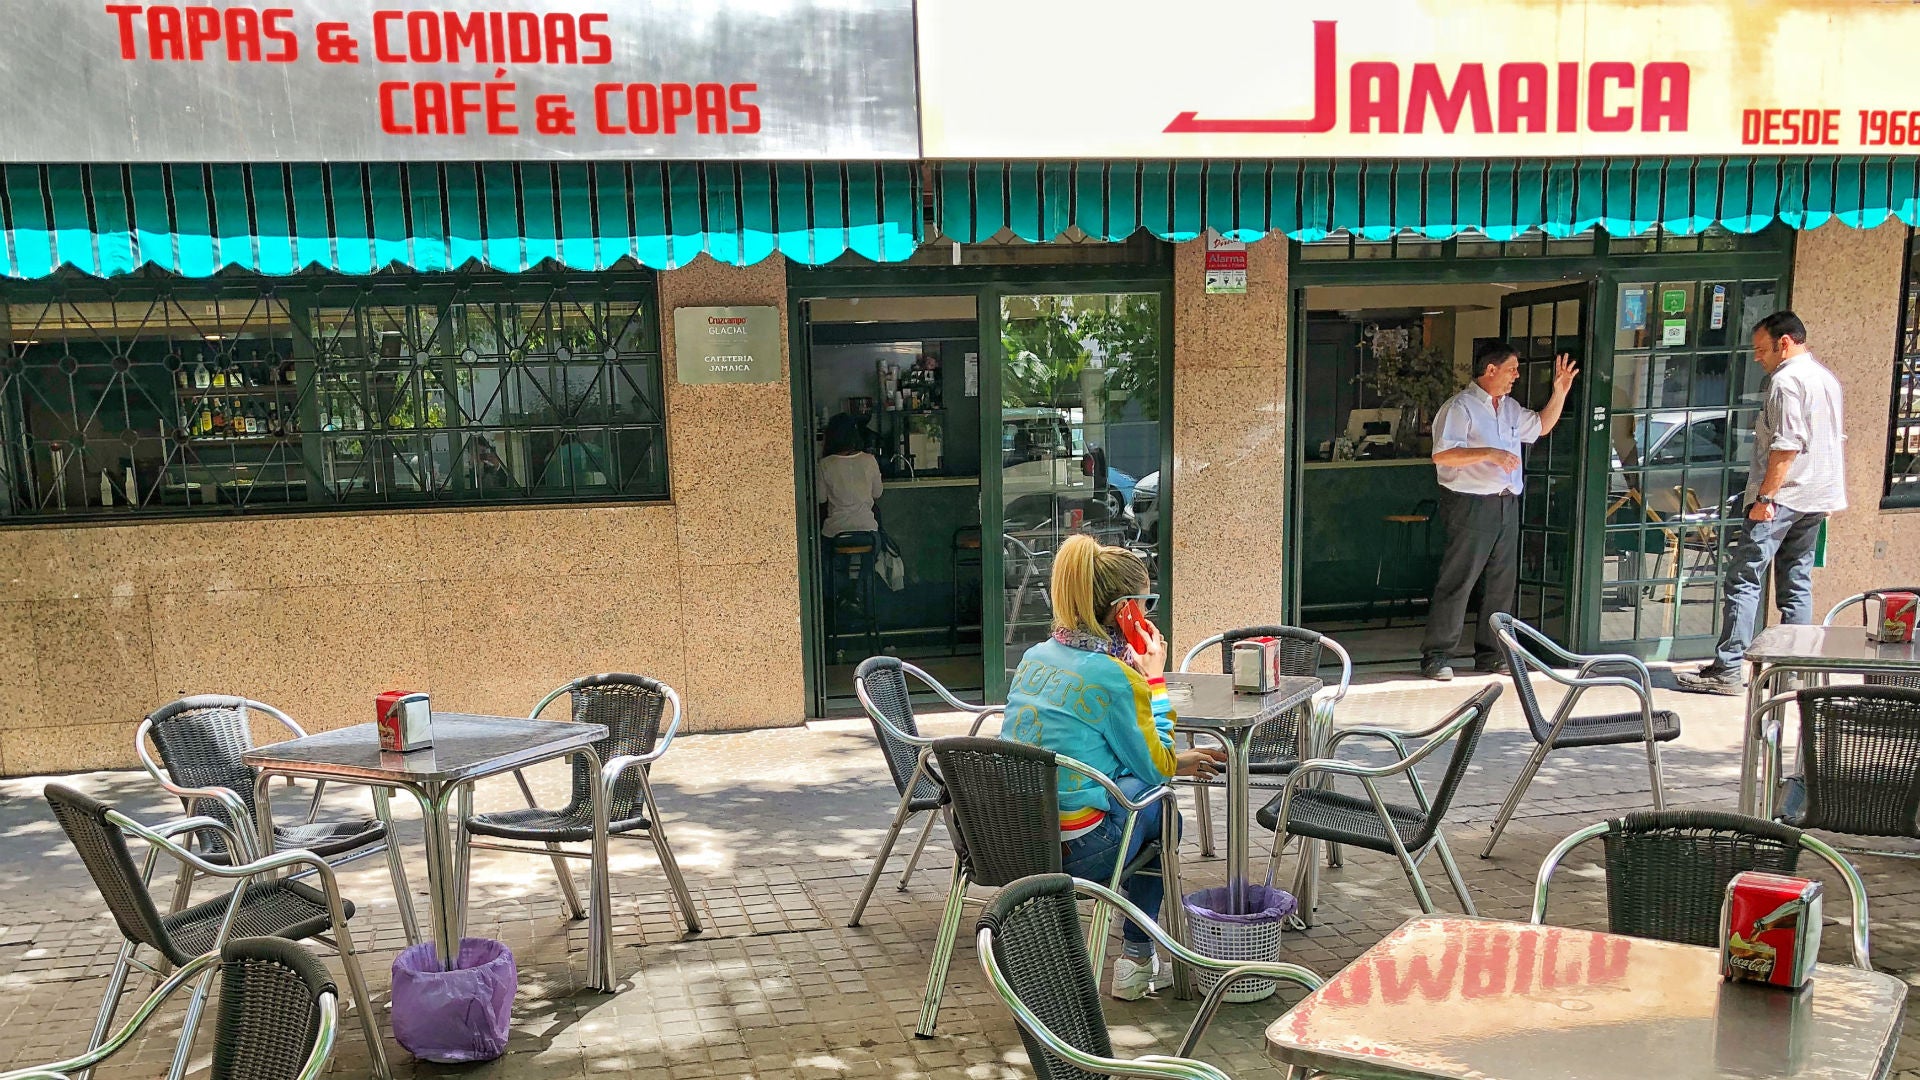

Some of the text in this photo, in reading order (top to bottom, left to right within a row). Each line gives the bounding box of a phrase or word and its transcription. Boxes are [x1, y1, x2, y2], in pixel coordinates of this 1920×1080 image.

[106, 5, 612, 65] TAPAS & COMIDAS
[1163, 21, 1691, 134] JAMAICA
[379, 69, 762, 136] CAFÉ & COPAS
[1742, 109, 1920, 146] DESDE 1966
[1210, 254, 1244, 262] Alarma
[708, 317, 747, 325] Cruzcampo
[708, 326, 748, 335] GLACIAL
[704, 355, 754, 363] CAFETERIA
[708, 364, 751, 372] JAMAICA
[1729, 954, 1773, 972] Coca-Cola
